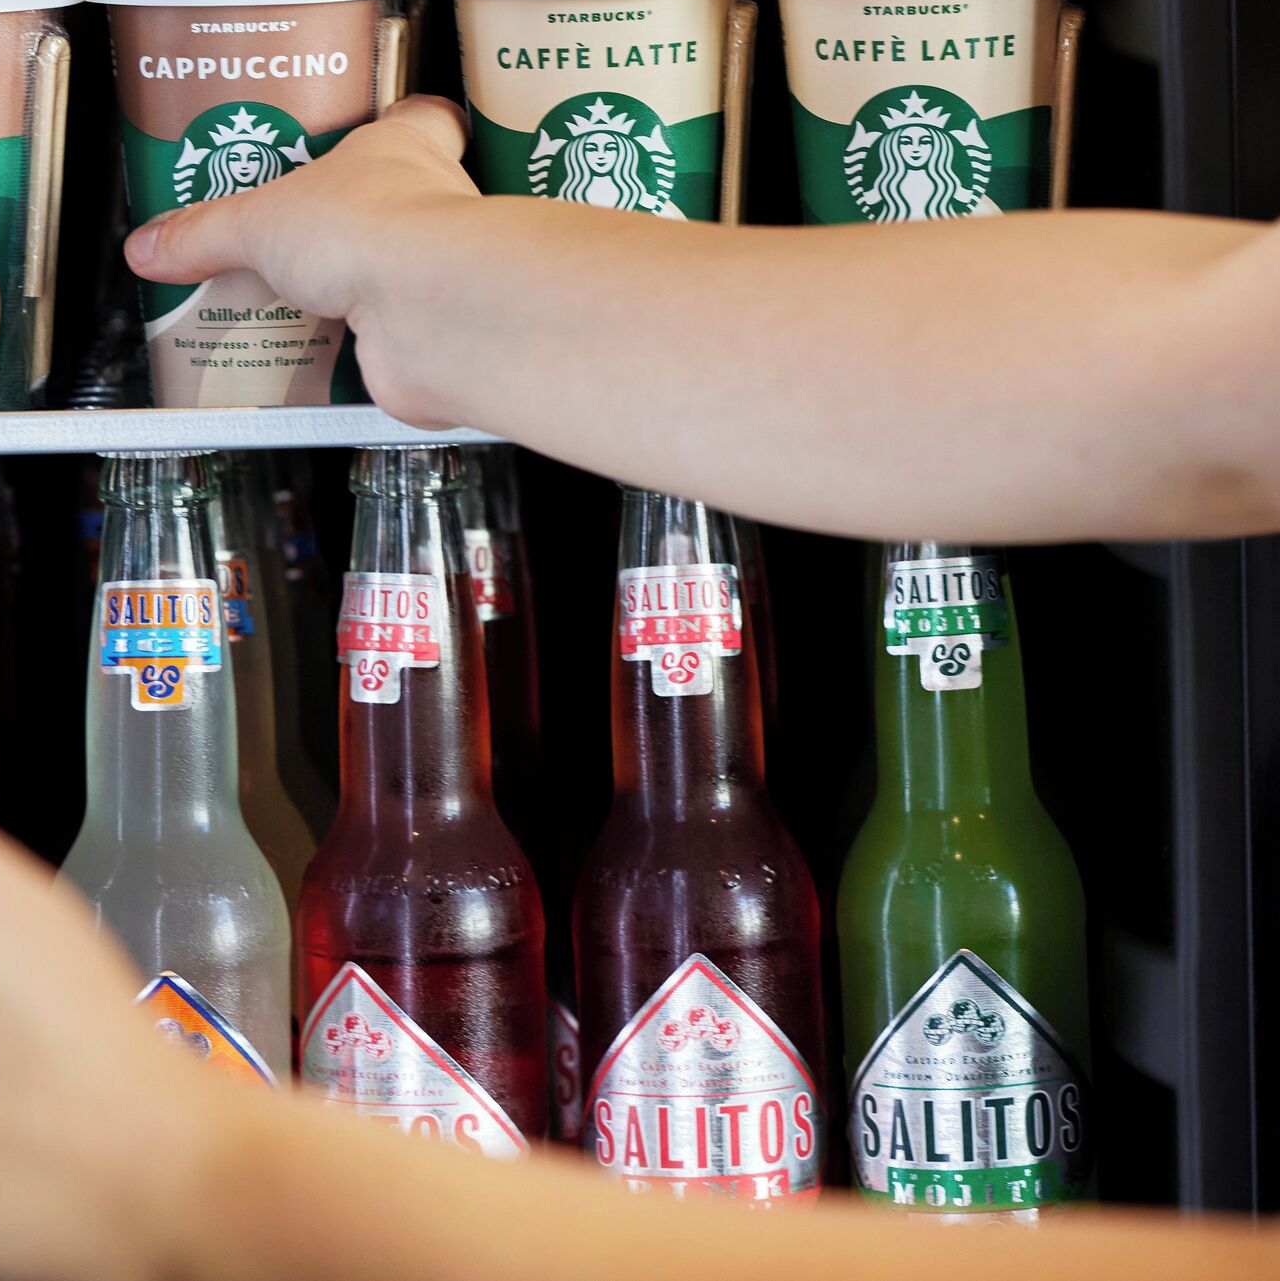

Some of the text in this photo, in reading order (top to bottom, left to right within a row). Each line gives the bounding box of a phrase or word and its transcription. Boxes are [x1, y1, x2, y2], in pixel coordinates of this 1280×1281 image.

[496, 40, 699, 70] CAFFÈ LATTE
[814, 33, 1017, 62] CAFFÈ LATTE
[138, 51, 349, 80] CAPPUCCINO
[198, 306, 303, 322] Chilled Coffee
[174, 335, 331, 354] Bold espresso Creamy milk
[190, 356, 316, 368] Hints of cocoa flavour
[626, 579, 731, 614] SALITOS
[894, 568, 1000, 605] SALITOS
[107, 593, 212, 627] SALITOS
[896, 614, 982, 634] MOJIT
[628, 616, 729, 636] PINK
[111, 637, 212, 654] ICE
[593, 1092, 816, 1171] SALITOS
[859, 1083, 1082, 1163] SALITOS
